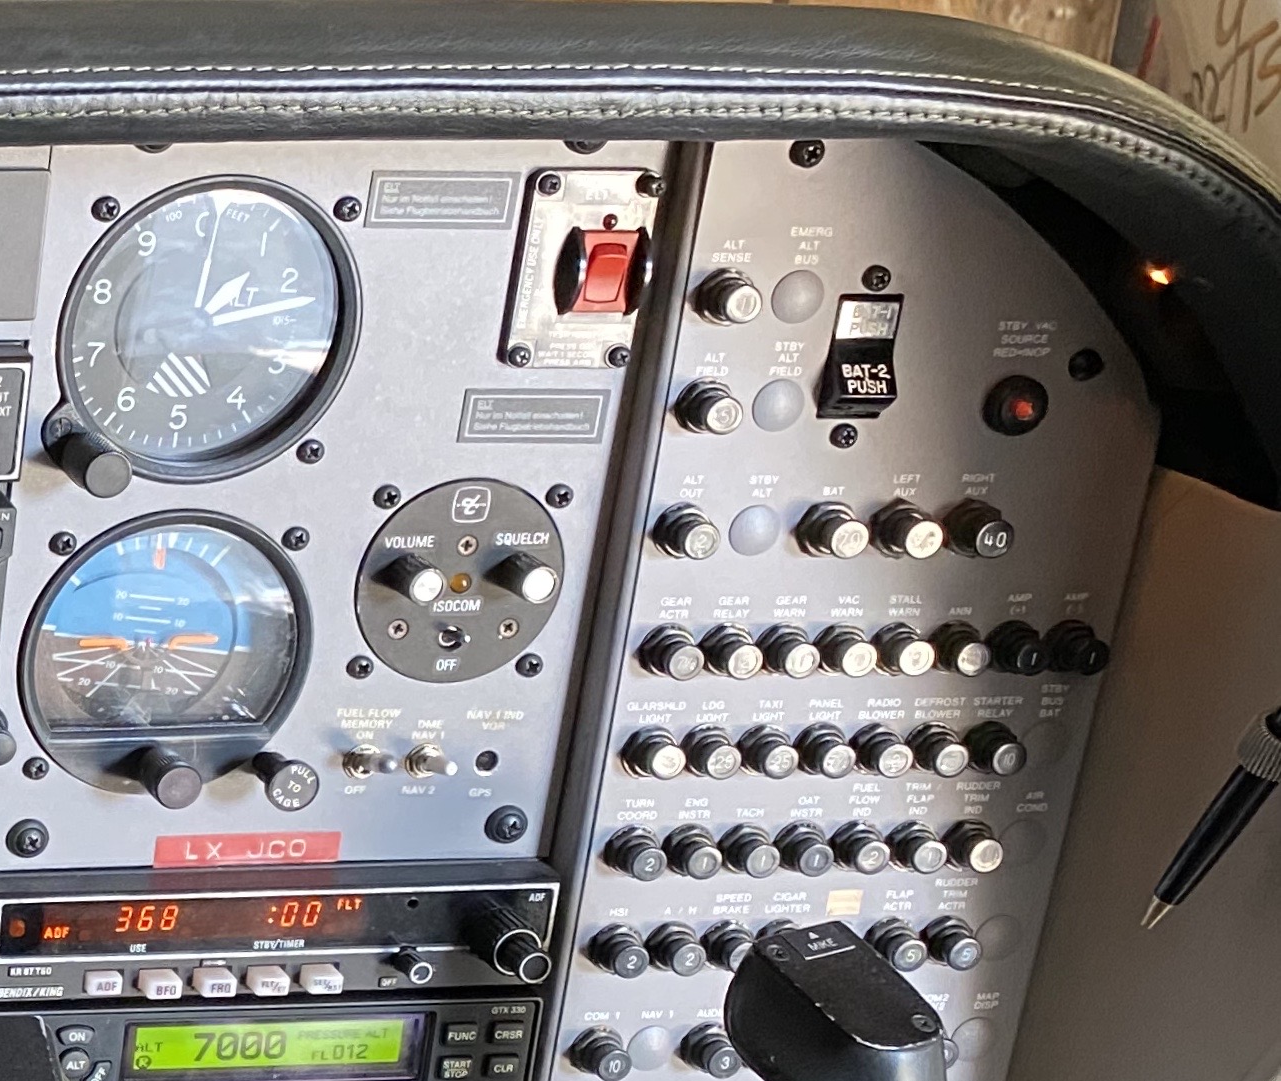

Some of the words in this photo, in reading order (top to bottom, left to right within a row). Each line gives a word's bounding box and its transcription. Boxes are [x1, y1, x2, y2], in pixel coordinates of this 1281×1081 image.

[842, 364, 890, 379] BAT-2
[848, 379, 886, 393] PUSH
[384, 534, 436, 549] VOLUME
[496, 532, 549, 546] SQUELCH
[432, 598, 482, 613] ISOCOM
[435, 658, 458, 672] OFF
[625, 798, 655, 809] TURN
[616, 810, 658, 821] COORD
[736, 807, 765, 818] TACH
[186, 841, 221, 860] LX
[247, 839, 306, 859] JCO
[116, 905, 179, 932] 368
[67, 1030, 86, 1043] ON
[447, 1030, 477, 1041] FUNC
[494, 1029, 524, 1040] CRSR
[194, 1031, 285, 1061] 7000
[493, 1063, 514, 1073] CLR
